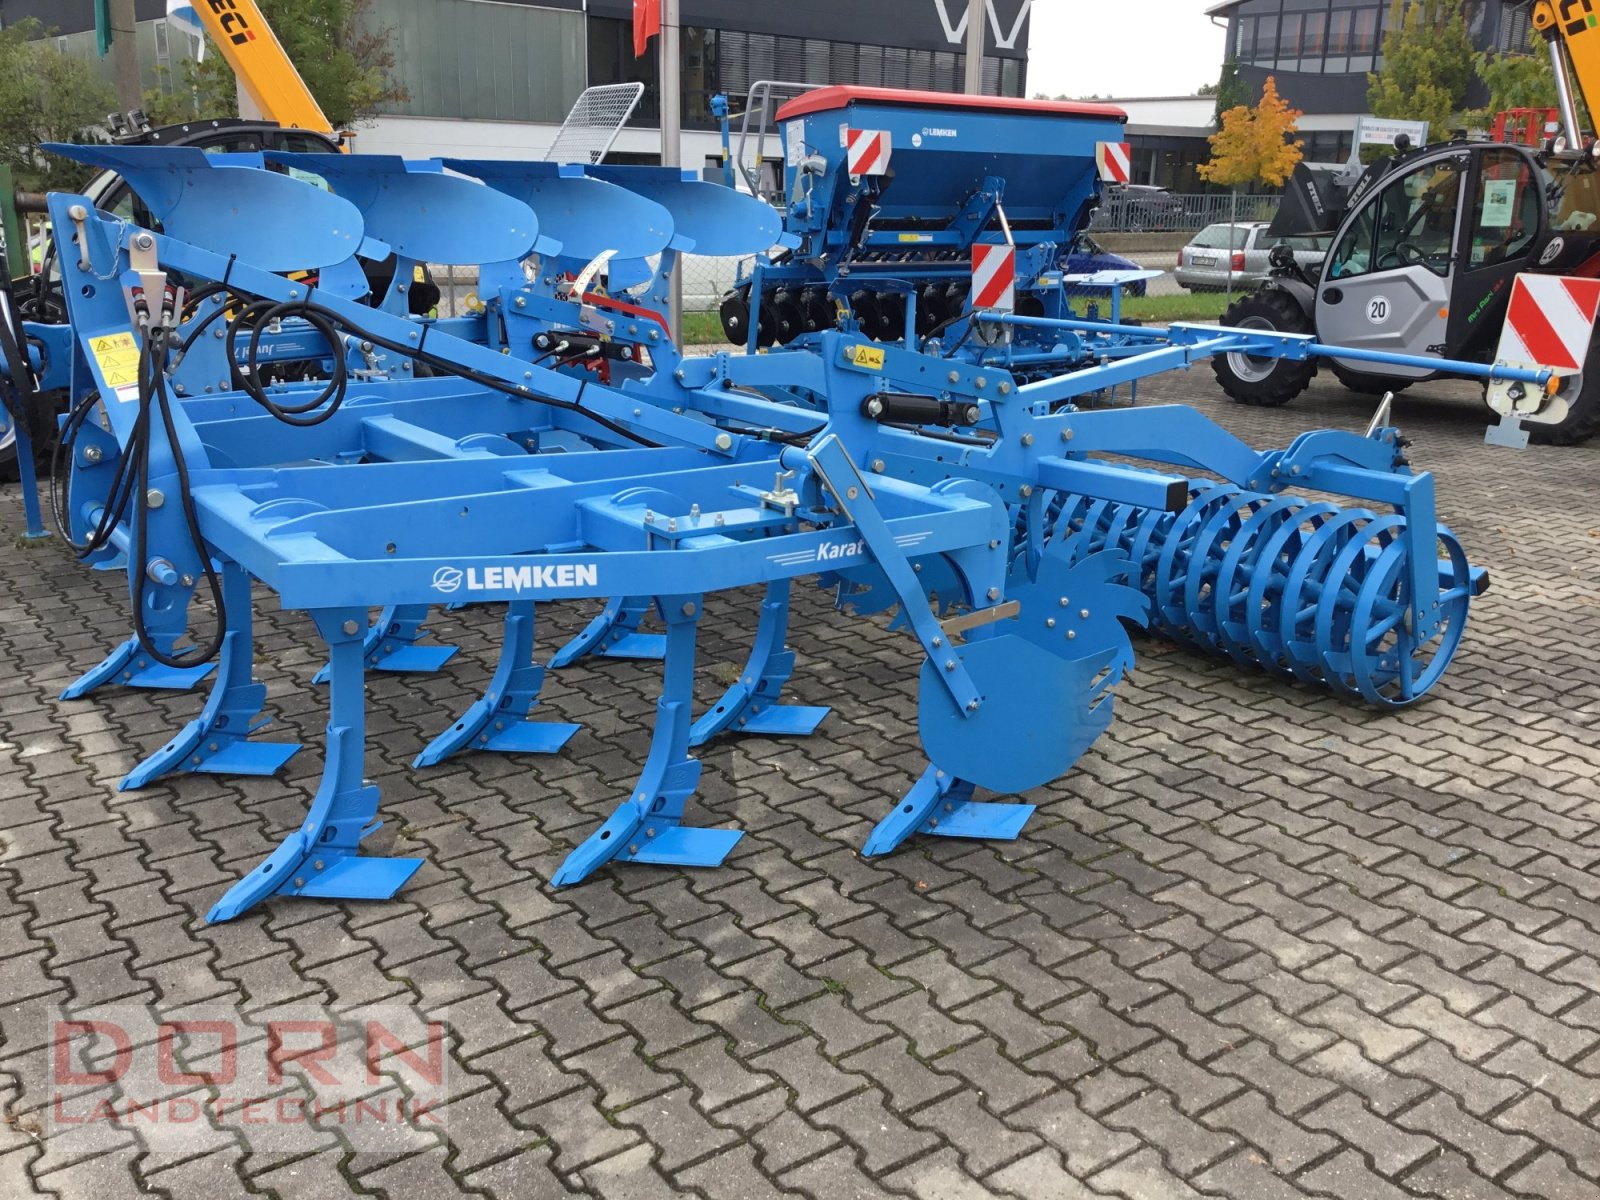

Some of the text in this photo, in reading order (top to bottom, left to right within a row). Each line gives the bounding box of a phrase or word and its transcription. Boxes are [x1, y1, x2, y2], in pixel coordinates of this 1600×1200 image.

[929, 127, 958, 137] LEMKEN
[1306, 181, 1324, 216] STOLL
[1346, 173, 1373, 208] STOLL
[1543, 242, 1561, 259] 20
[1371, 301, 1386, 318] 20
[817, 539, 865, 561] Karat
[467, 564, 598, 594] LEMKEN
